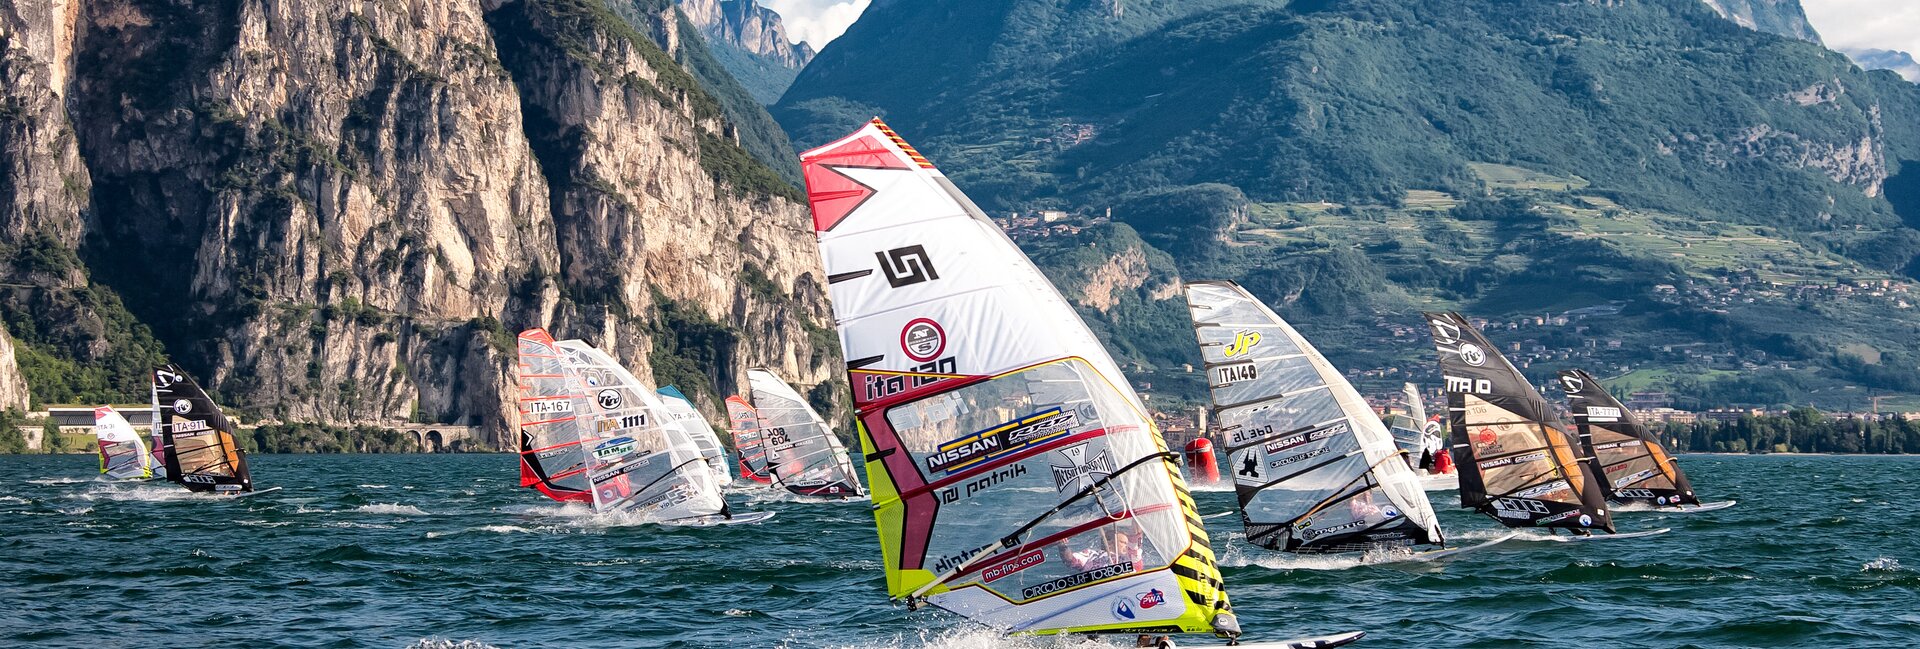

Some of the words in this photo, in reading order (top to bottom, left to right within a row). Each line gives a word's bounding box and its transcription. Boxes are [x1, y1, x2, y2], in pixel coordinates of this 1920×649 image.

[1223, 331, 1262, 358] JP
[865, 374, 906, 401] ita
[928, 435, 999, 468] NISSAN
[1266, 435, 1305, 452] NISSAN
[594, 470, 620, 482] NISSAN
[967, 464, 1027, 497] patrik
[1023, 580, 1067, 599] CIRCOLO
[1066, 574, 1089, 588] SURF
[1089, 562, 1133, 581] TORBOLE
